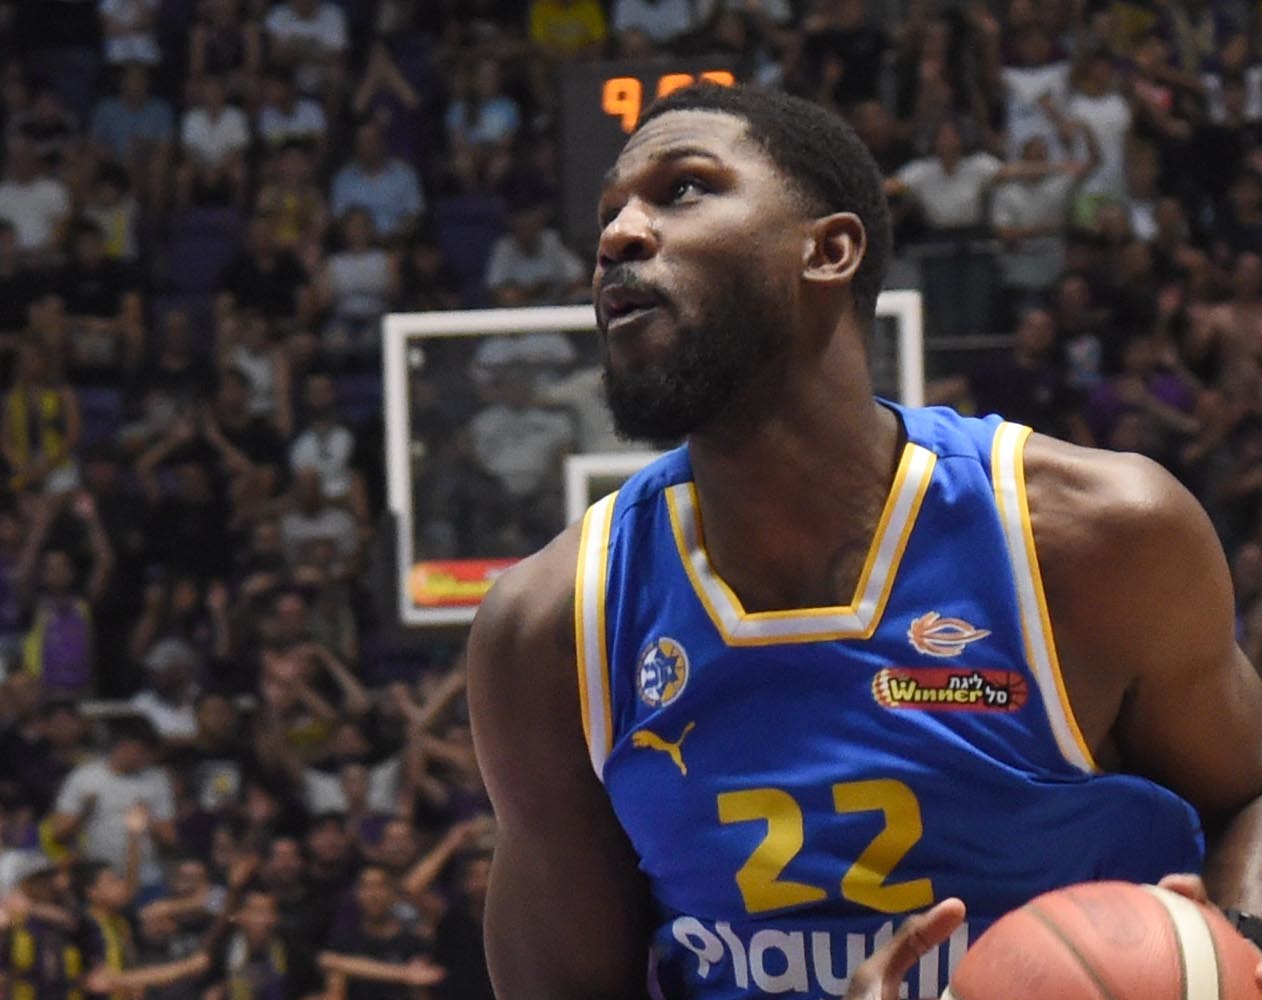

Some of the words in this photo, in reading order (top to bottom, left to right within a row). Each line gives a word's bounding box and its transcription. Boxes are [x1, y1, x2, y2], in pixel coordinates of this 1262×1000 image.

[889, 680, 983, 702] Winner
[985, 686, 1008, 704] סל
[716, 778, 934, 914] 22
